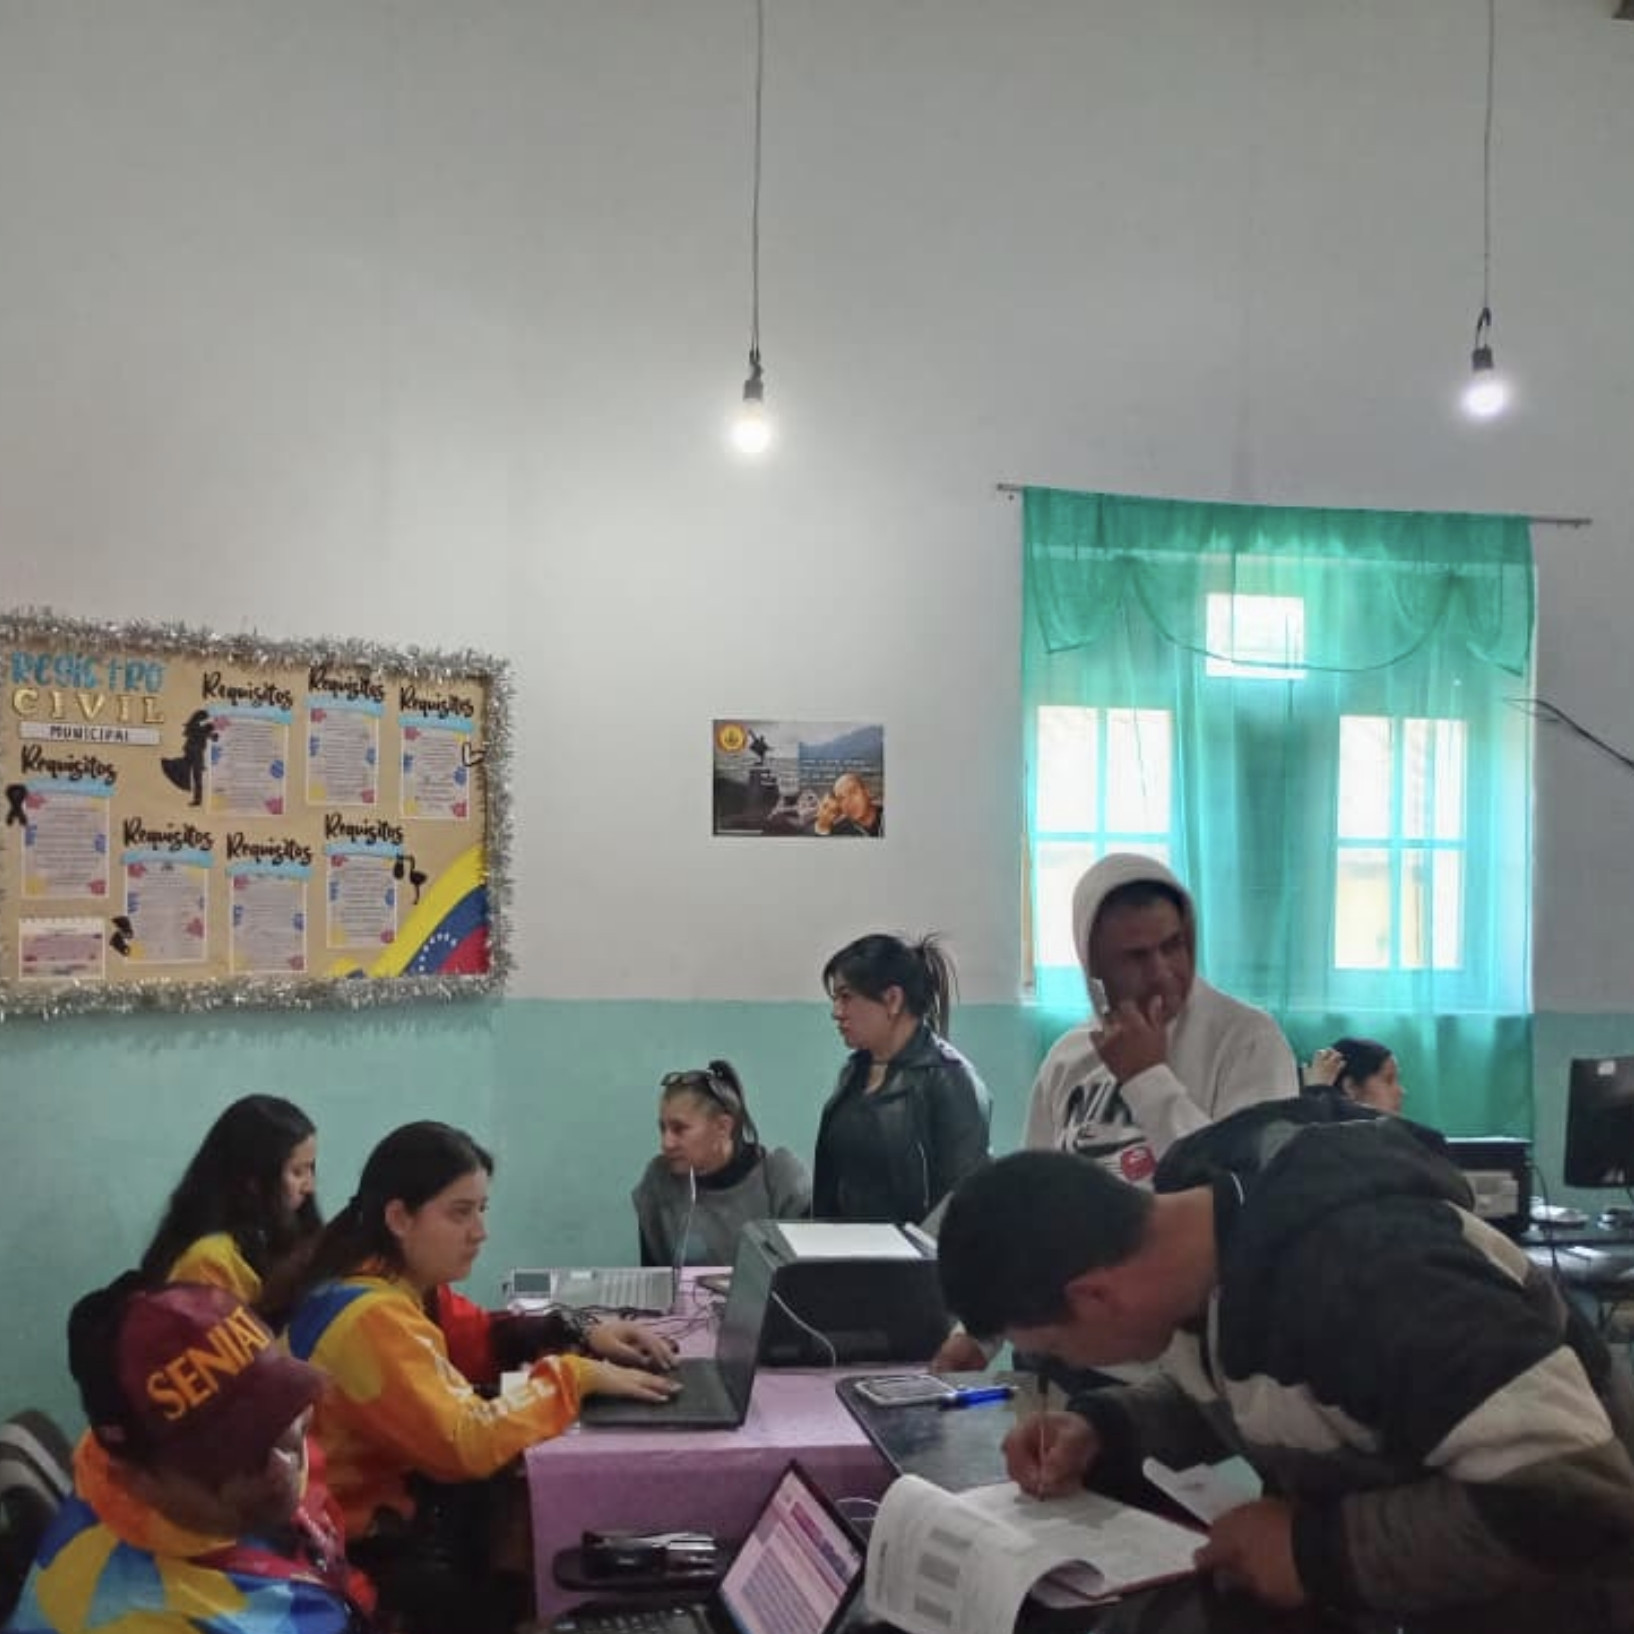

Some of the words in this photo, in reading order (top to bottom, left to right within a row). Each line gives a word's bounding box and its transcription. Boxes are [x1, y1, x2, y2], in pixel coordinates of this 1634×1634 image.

[203, 671, 293, 711] Requisitos
[308, 661, 385, 704] Requisitos
[12, 688, 164, 724] CIVIL
[401, 685, 474, 719] Requisitos
[21, 745, 117, 785] Requisitos
[123, 816, 215, 851] Requisitos
[325, 812, 403, 845] Requisitos
[226, 832, 312, 867] Requisitos
